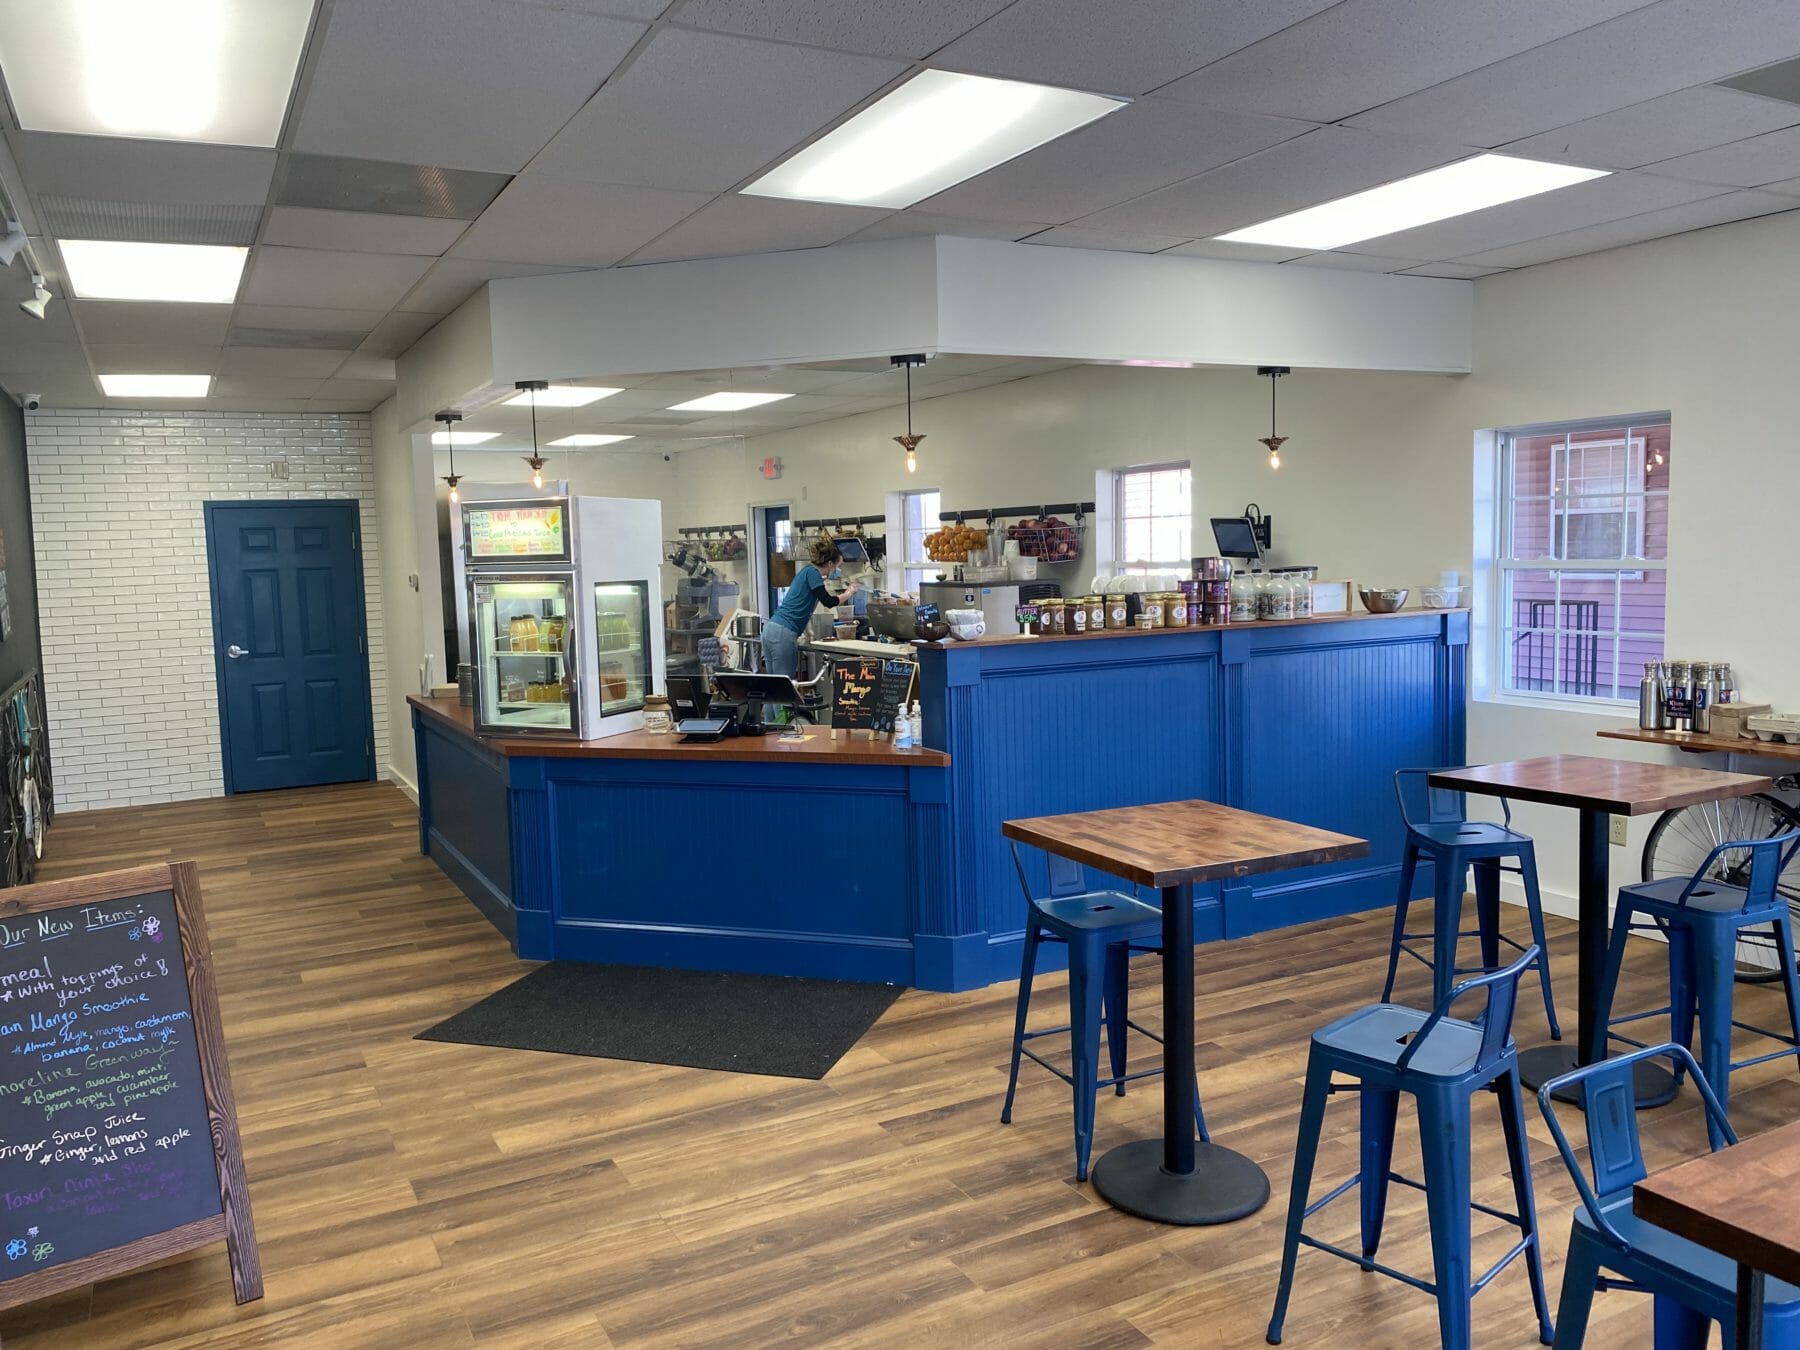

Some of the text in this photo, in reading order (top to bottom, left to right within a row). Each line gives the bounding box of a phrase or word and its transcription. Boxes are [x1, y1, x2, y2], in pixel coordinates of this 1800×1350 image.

[836, 668, 856, 680] The
[38, 915, 74, 937] New
[80, 904, 143, 928] Items:
[61, 963, 124, 986] toppings
[134, 953, 149, 967] of
[56, 984, 96, 1008] your
[0, 993, 149, 1037] ain Mango Smoothie
[102, 1033, 146, 1050] coconut
[44, 1101, 72, 1121] green
[117, 1073, 171, 1094] cucumber
[52, 1126, 97, 1146] Snap
[104, 1112, 146, 1129] Juice
[105, 1128, 148, 1148] lemons
[92, 1127, 191, 1166] and red apple
